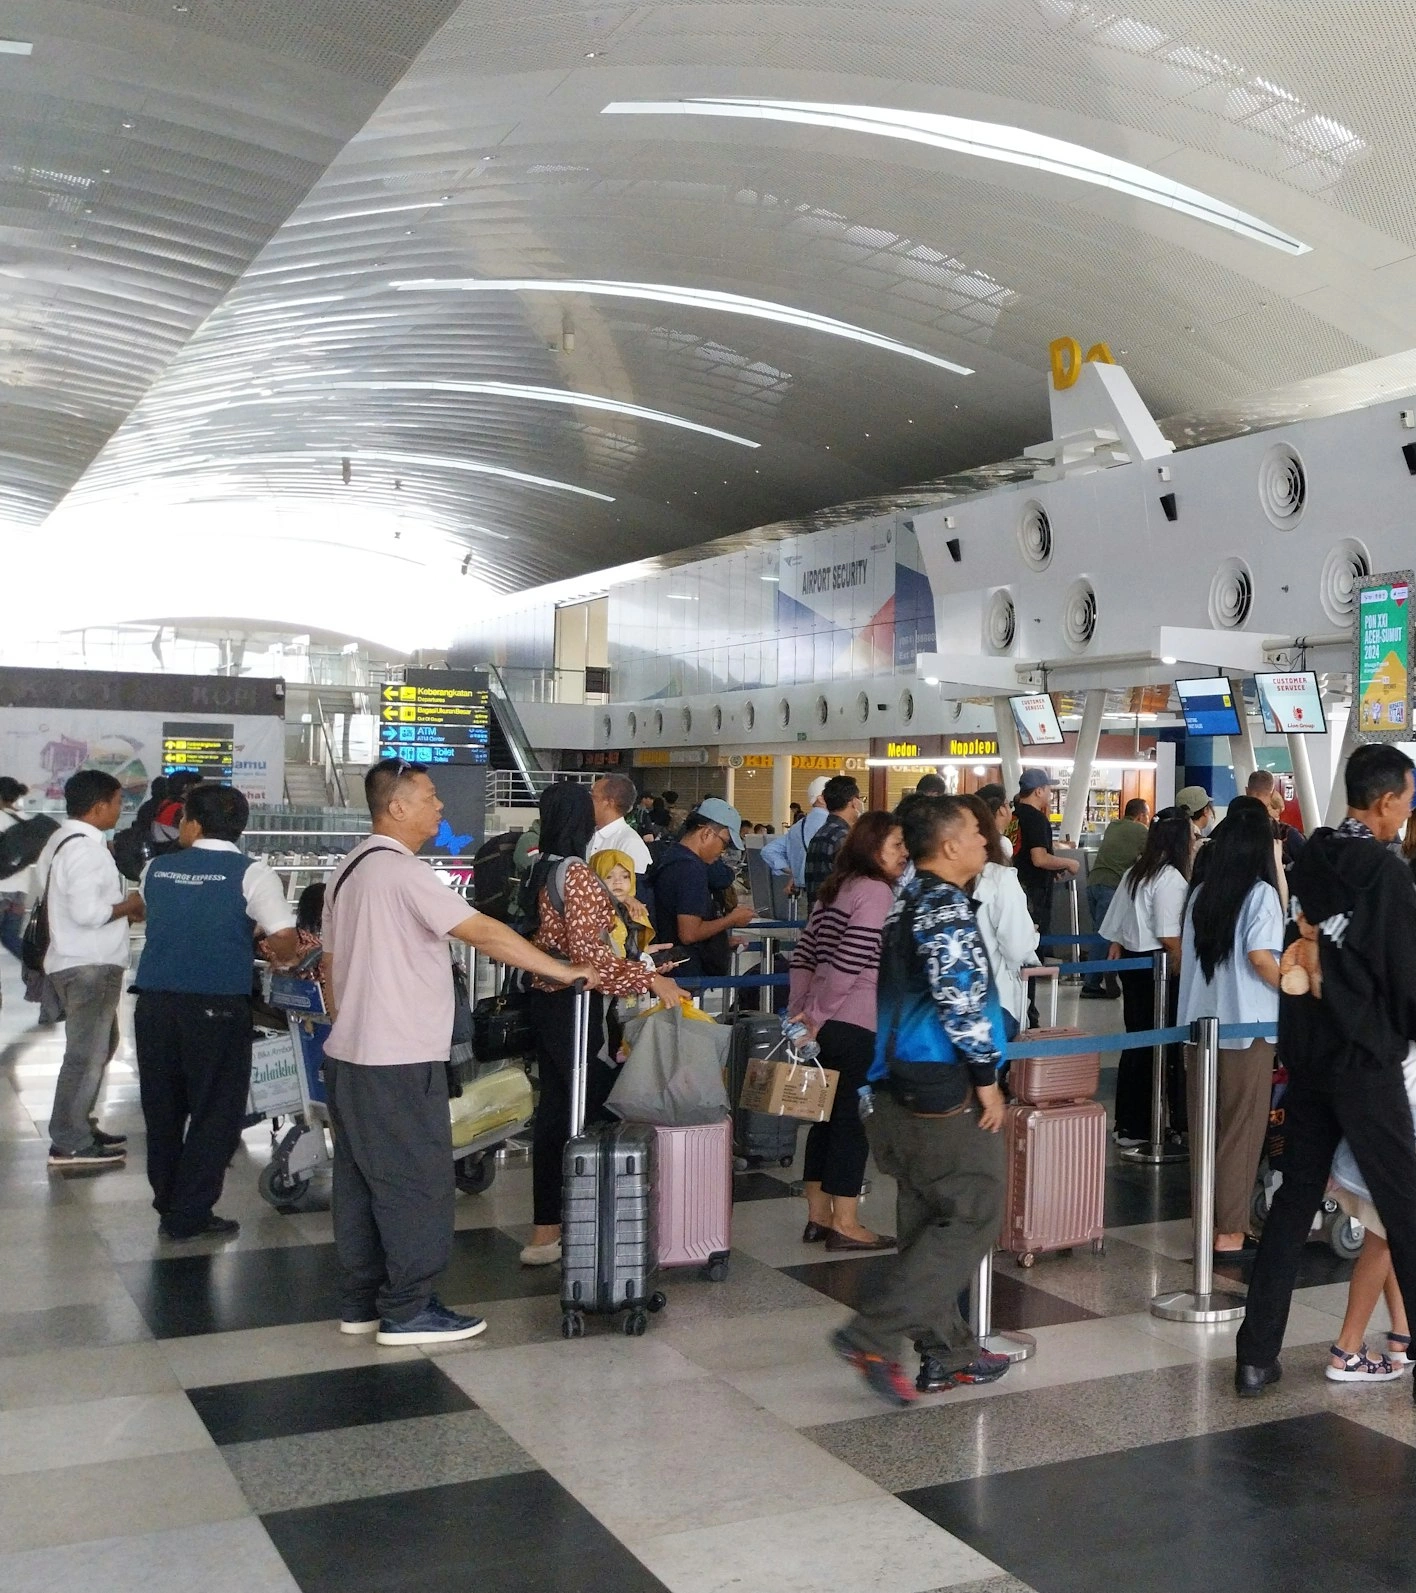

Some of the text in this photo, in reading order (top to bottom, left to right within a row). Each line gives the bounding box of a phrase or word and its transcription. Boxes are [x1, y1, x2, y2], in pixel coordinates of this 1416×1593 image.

[802, 559, 868, 595] AIRPORT SECURITY
[1364, 613, 1388, 630] PON XXI
[1364, 627, 1402, 645] ACEH-SUMUT
[1364, 645, 1380, 660] 2024
[417, 687, 473, 698] Keberangkatan
[417, 707, 438, 715] Bagasi
[417, 727, 437, 735] ATM
[434, 747, 454, 756] Toilet
[888, 743, 918, 757] Medan
[154, 870, 222, 881] CONCIERGE EXPRESS
[252, 1060, 298, 1084] Zulaikha
